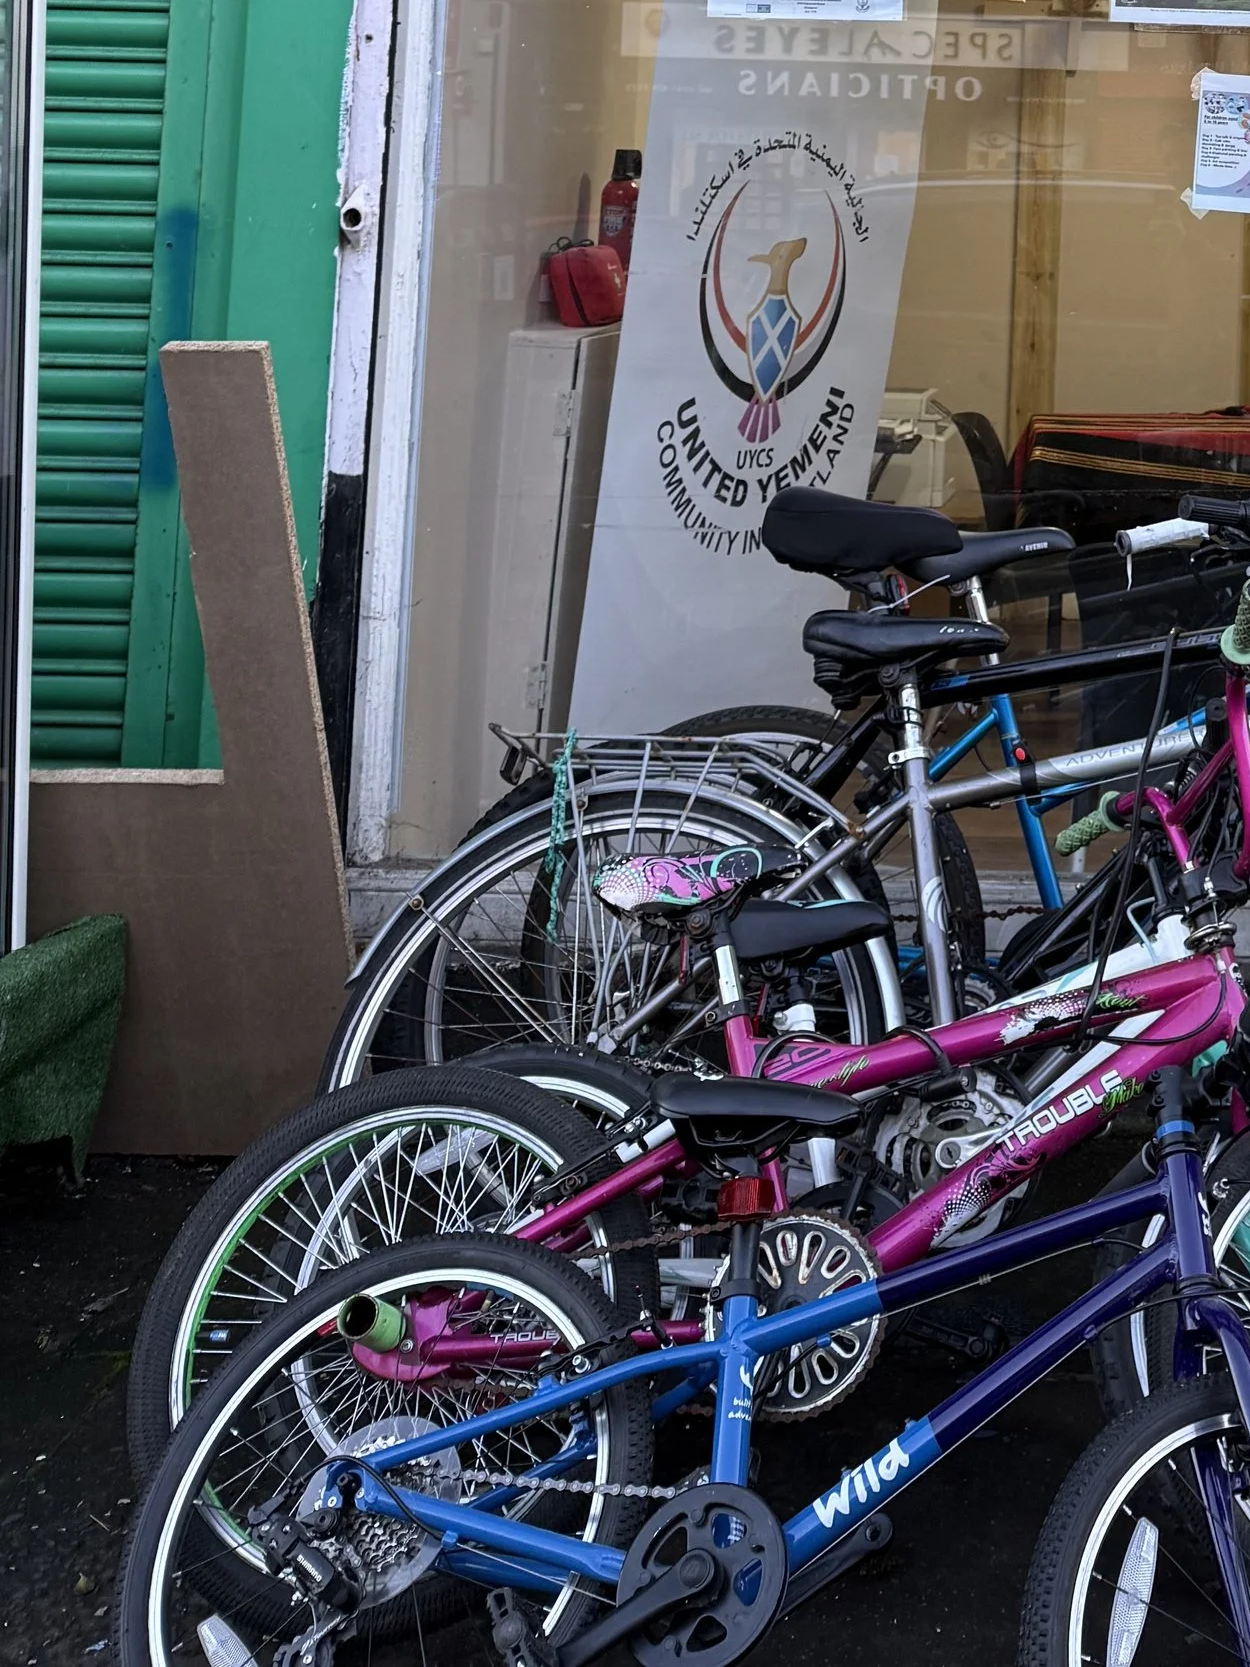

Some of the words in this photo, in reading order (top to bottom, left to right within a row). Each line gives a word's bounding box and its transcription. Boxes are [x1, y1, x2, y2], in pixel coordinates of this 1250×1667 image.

[676, 396, 749, 508] UNITED
[756, 385, 846, 505] YEMENI
[735, 447, 775, 471] UYCS
[656, 419, 740, 556] COMMUNITY
[296, 1554, 322, 1583] SHIMANO
